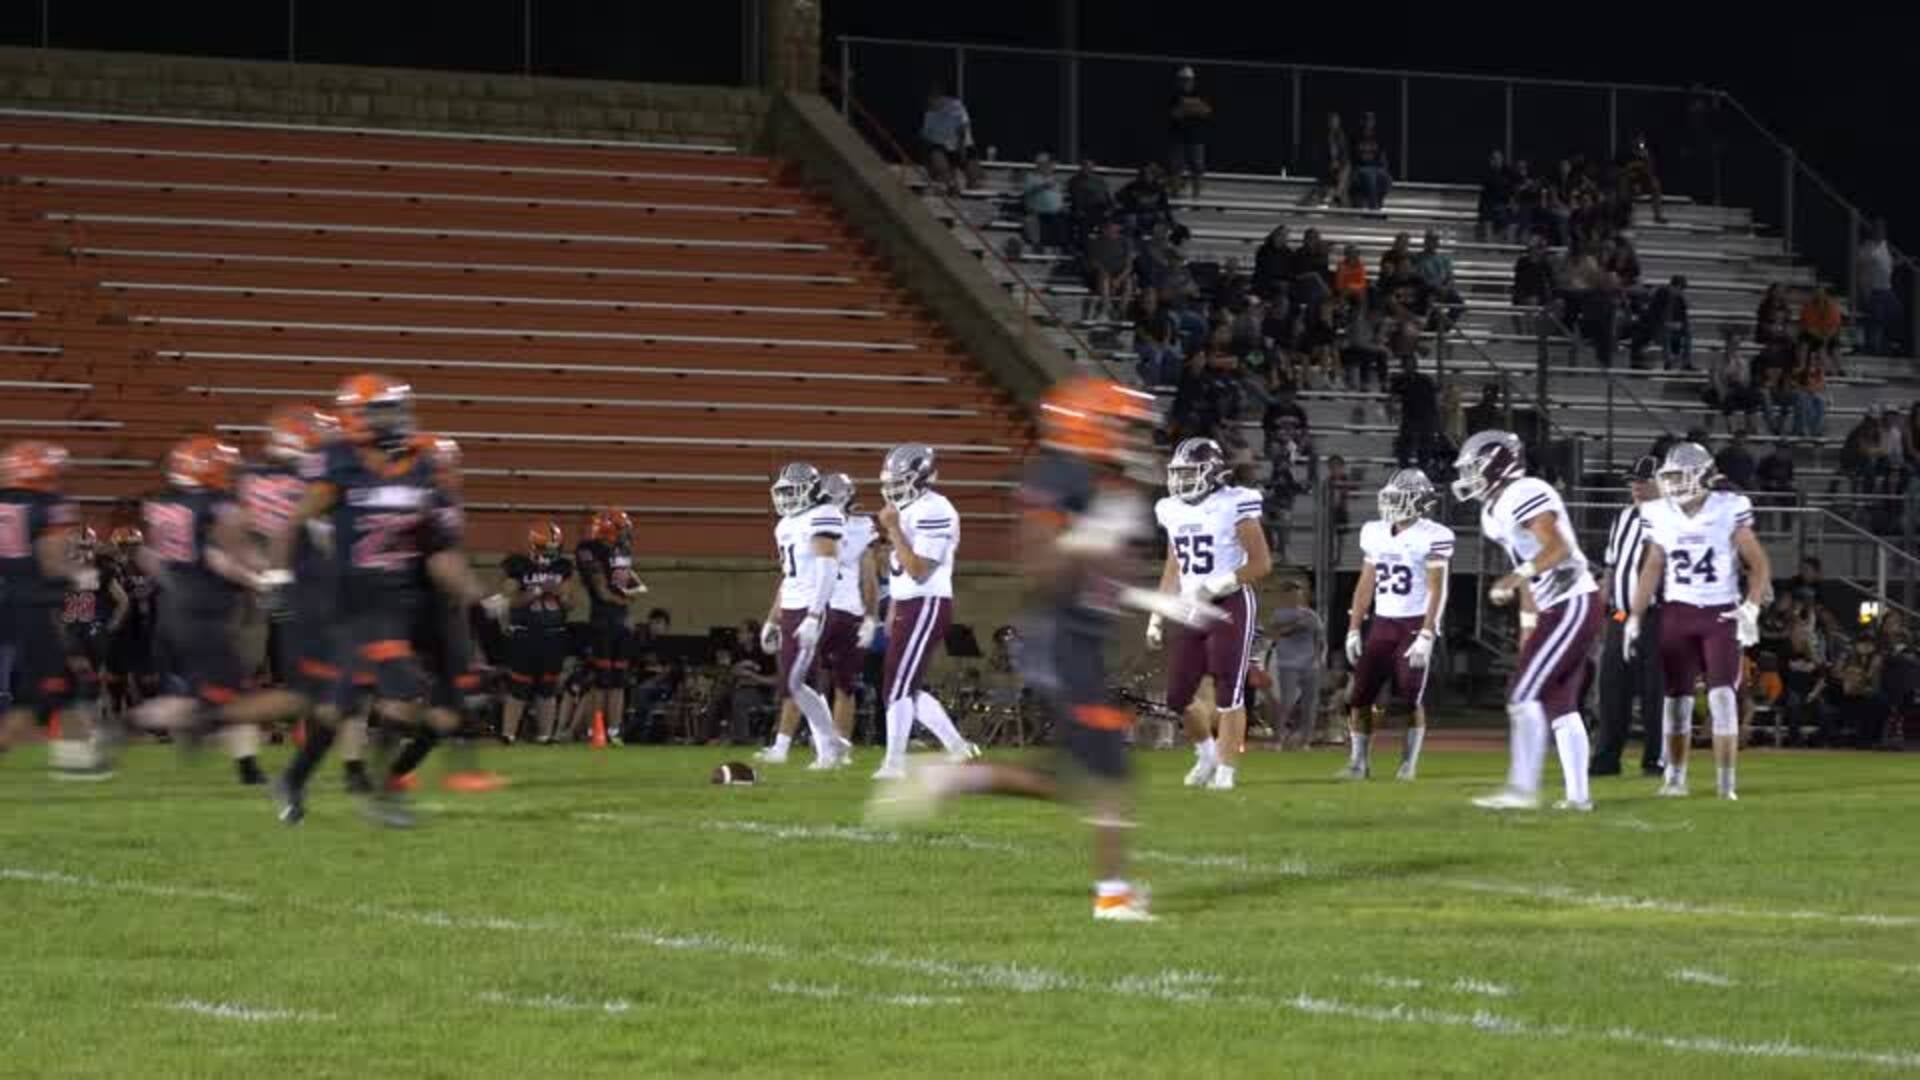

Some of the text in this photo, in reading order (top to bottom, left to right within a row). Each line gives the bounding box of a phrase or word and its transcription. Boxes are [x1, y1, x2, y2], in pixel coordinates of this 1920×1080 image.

[1174, 535, 1214, 575] 55
[1671, 546, 1718, 584] 24
[1376, 563, 1413, 595] 23
